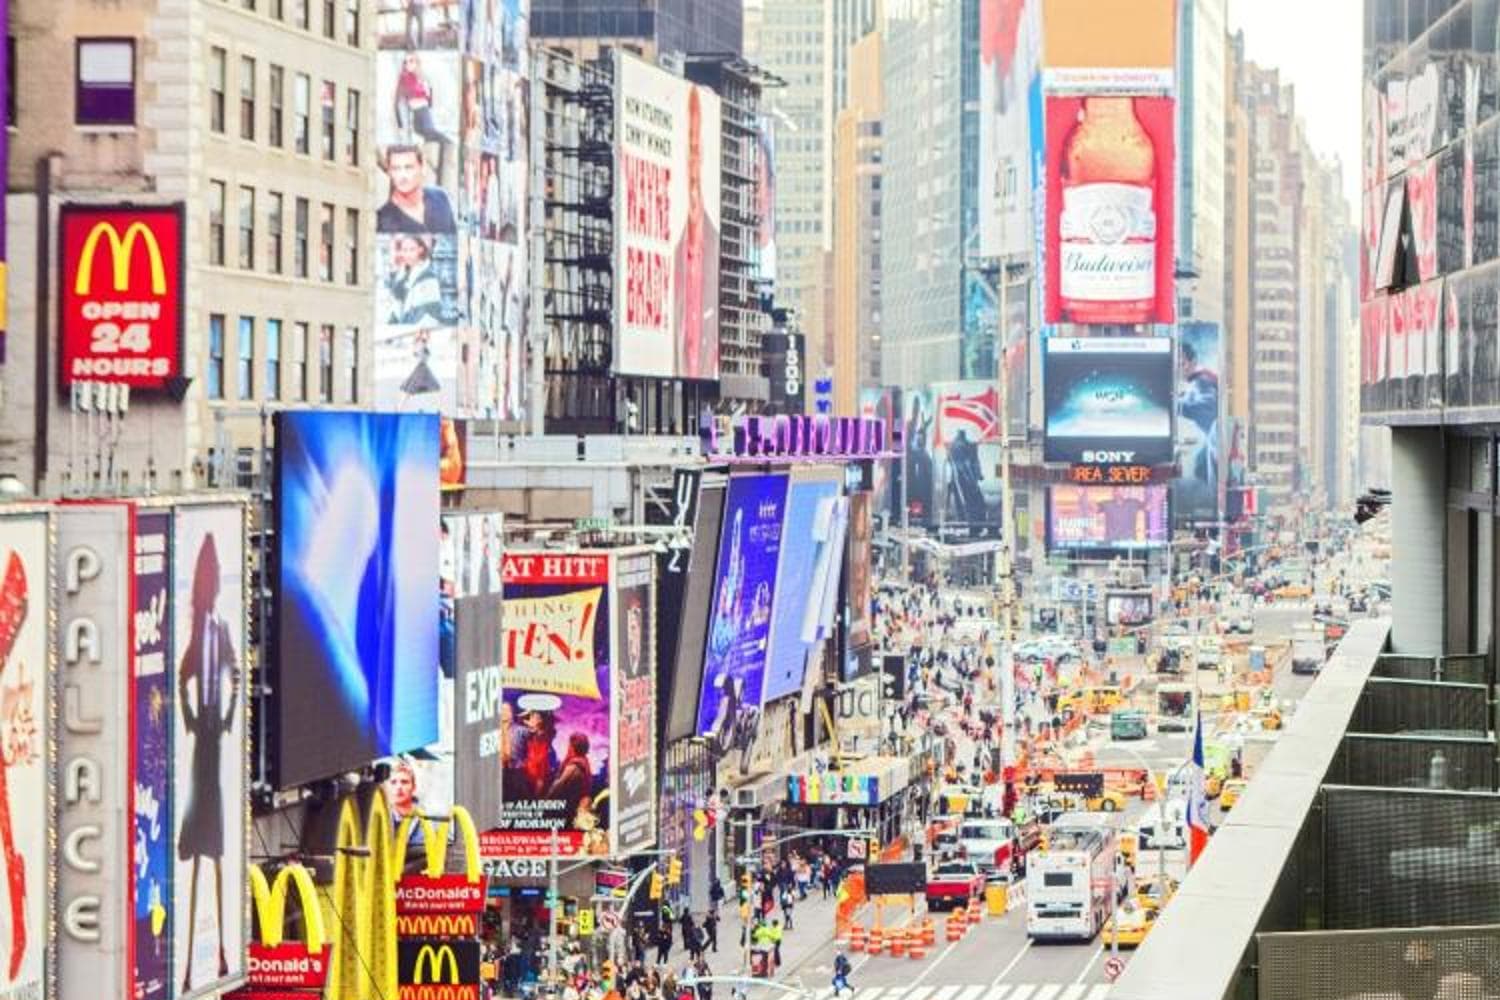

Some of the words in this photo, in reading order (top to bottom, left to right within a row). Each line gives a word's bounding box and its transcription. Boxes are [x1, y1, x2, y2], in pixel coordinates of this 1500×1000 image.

[624, 152, 671, 242] WAYNE
[627, 246, 671, 331] BRADY
[82, 302, 160, 320] OPEN
[90, 322, 151, 353] 24
[71, 356, 170, 377] HOURS
[1082, 450, 1135, 463] SONY
[65, 547, 103, 943] PALACE
[514, 819, 565, 829] MORMON
